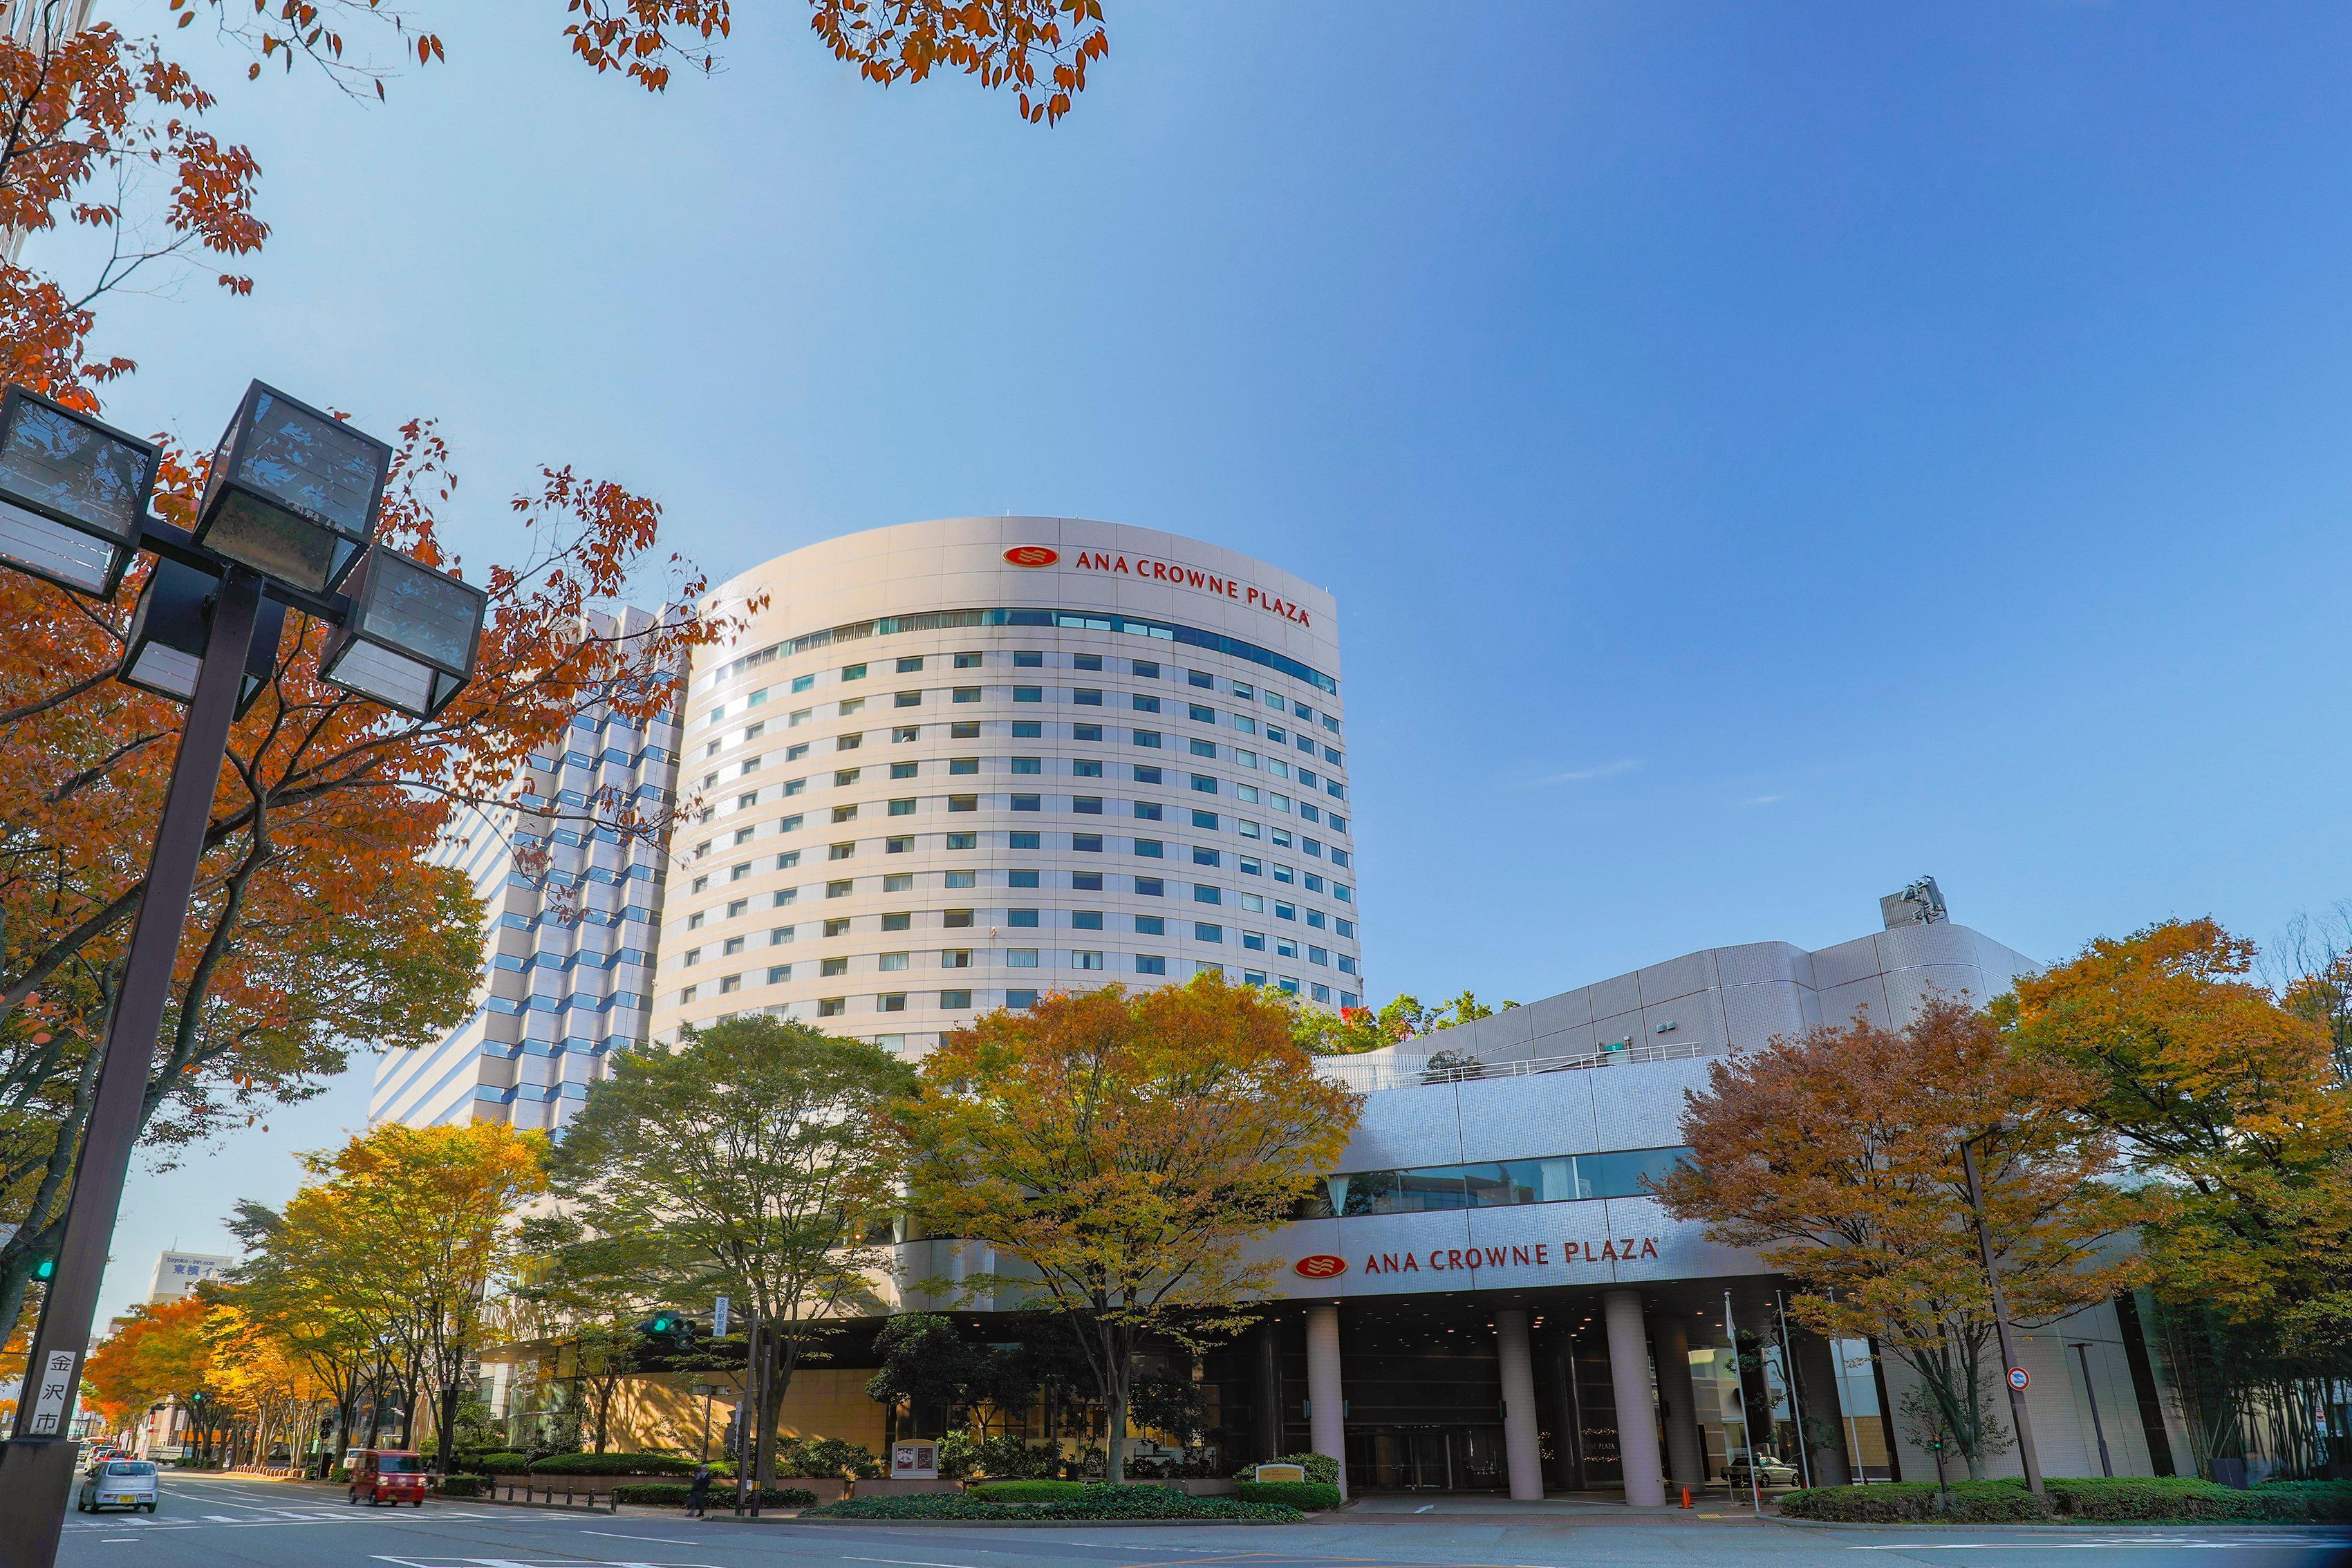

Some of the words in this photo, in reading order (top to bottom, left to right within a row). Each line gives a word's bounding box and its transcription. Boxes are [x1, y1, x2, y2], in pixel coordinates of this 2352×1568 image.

[1076, 552, 1128, 573] ANA
[1137, 560, 1238, 599] CROWNE
[1247, 587, 1309, 628] PLAZA
[1365, 1252, 1419, 1273] ANA
[1430, 1244, 1548, 1271] CROWNE
[1565, 1238, 1658, 1263] PLAZA
[716, 1299, 726, 1336] 金沢駅前南
[35, 1355, 72, 1430] 金沢市
